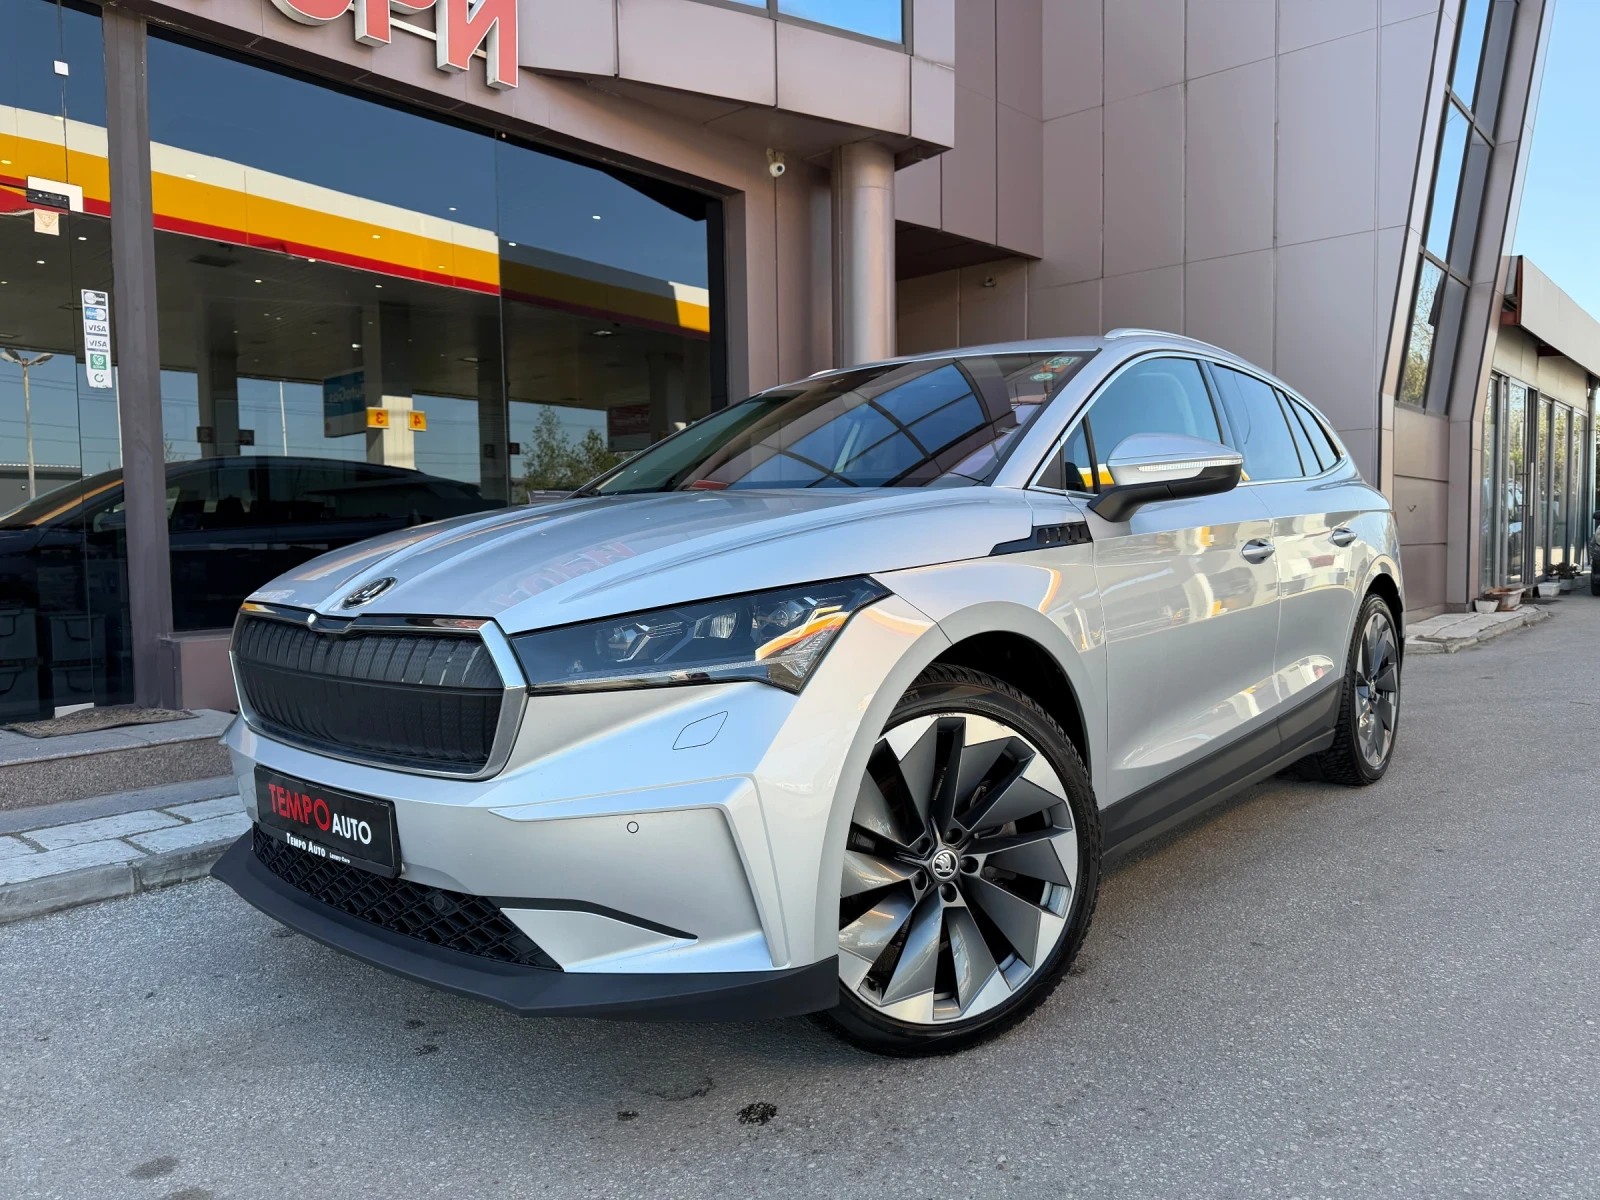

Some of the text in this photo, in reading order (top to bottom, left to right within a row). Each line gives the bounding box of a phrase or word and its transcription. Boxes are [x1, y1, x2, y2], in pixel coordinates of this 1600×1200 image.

[88, 324, 107, 333] VISA
[89, 340, 108, 348] VISA
[268, 784, 372, 845] TEMPO AUTO
